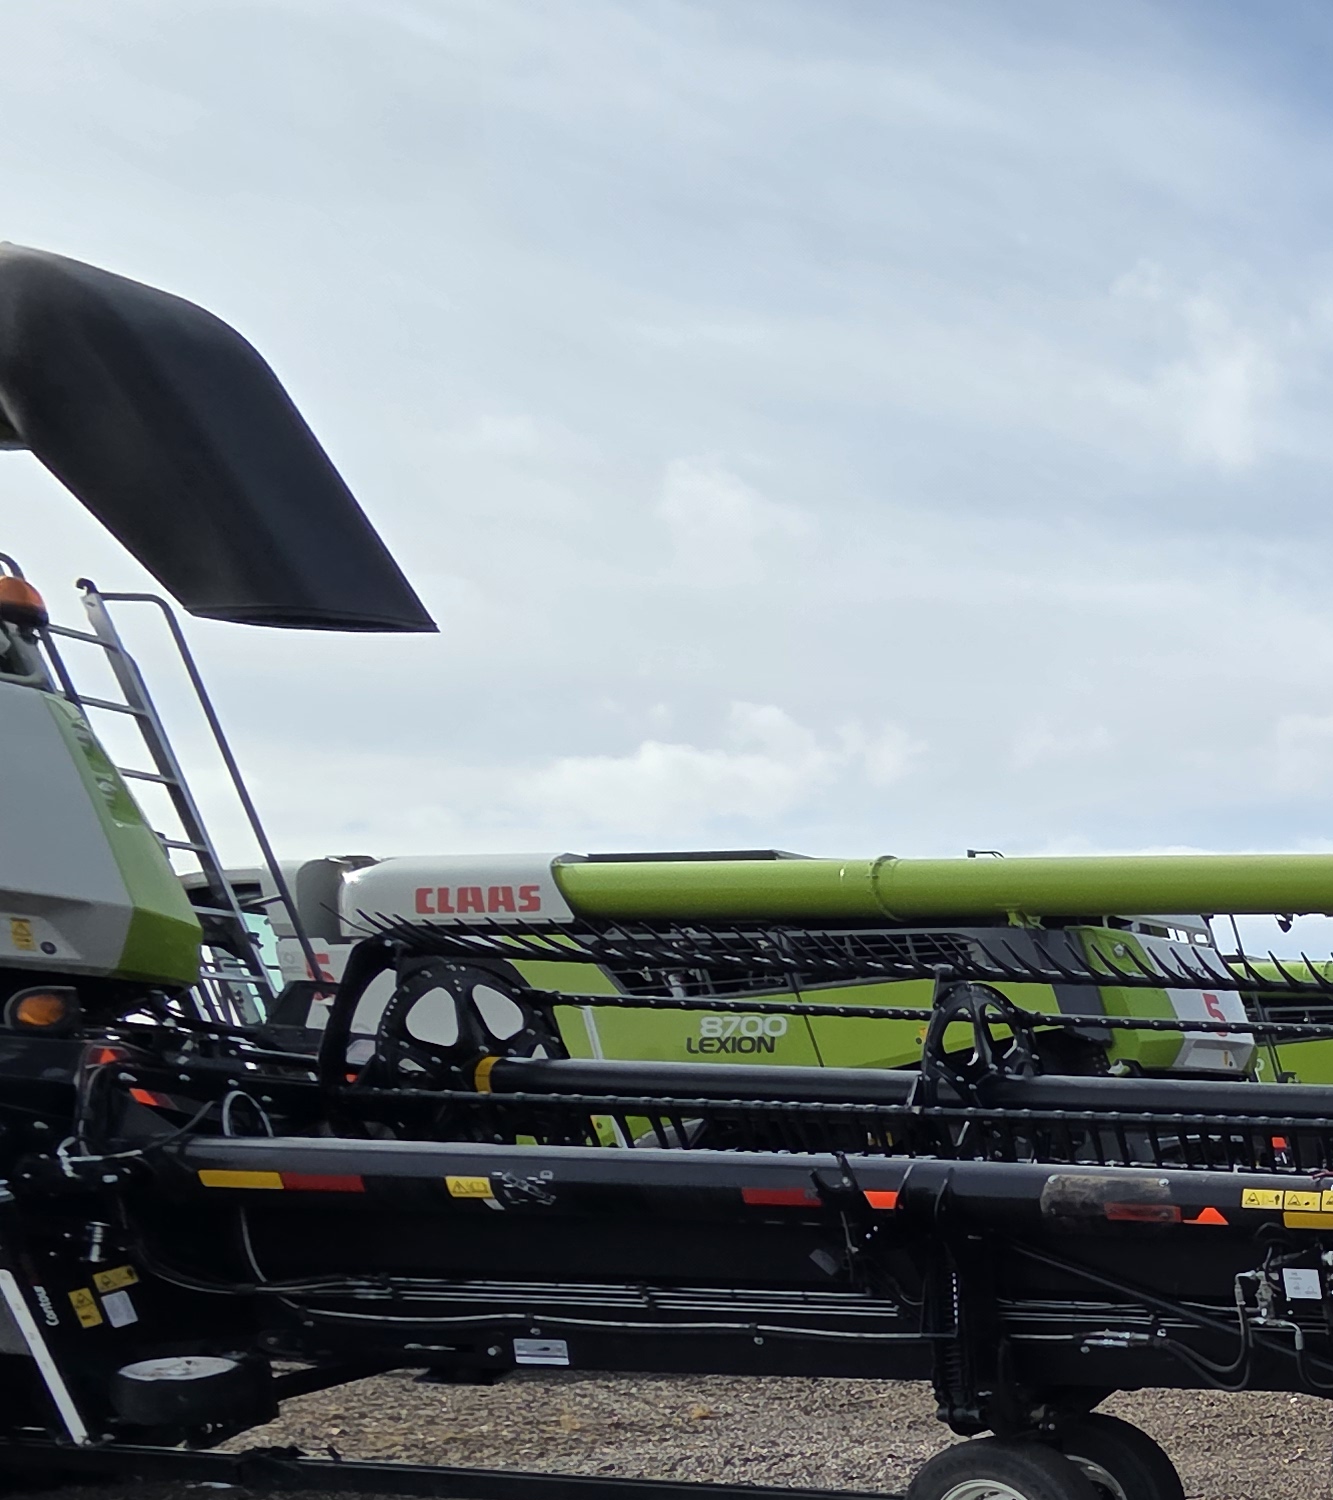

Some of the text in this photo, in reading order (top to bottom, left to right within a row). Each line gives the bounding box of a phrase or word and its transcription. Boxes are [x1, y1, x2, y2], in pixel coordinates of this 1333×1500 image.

[415, 885, 541, 914] CLAAS
[700, 1015, 788, 1037] 8700
[1202, 992, 1228, 1037] 5
[686, 1036, 776, 1054] LEXION
